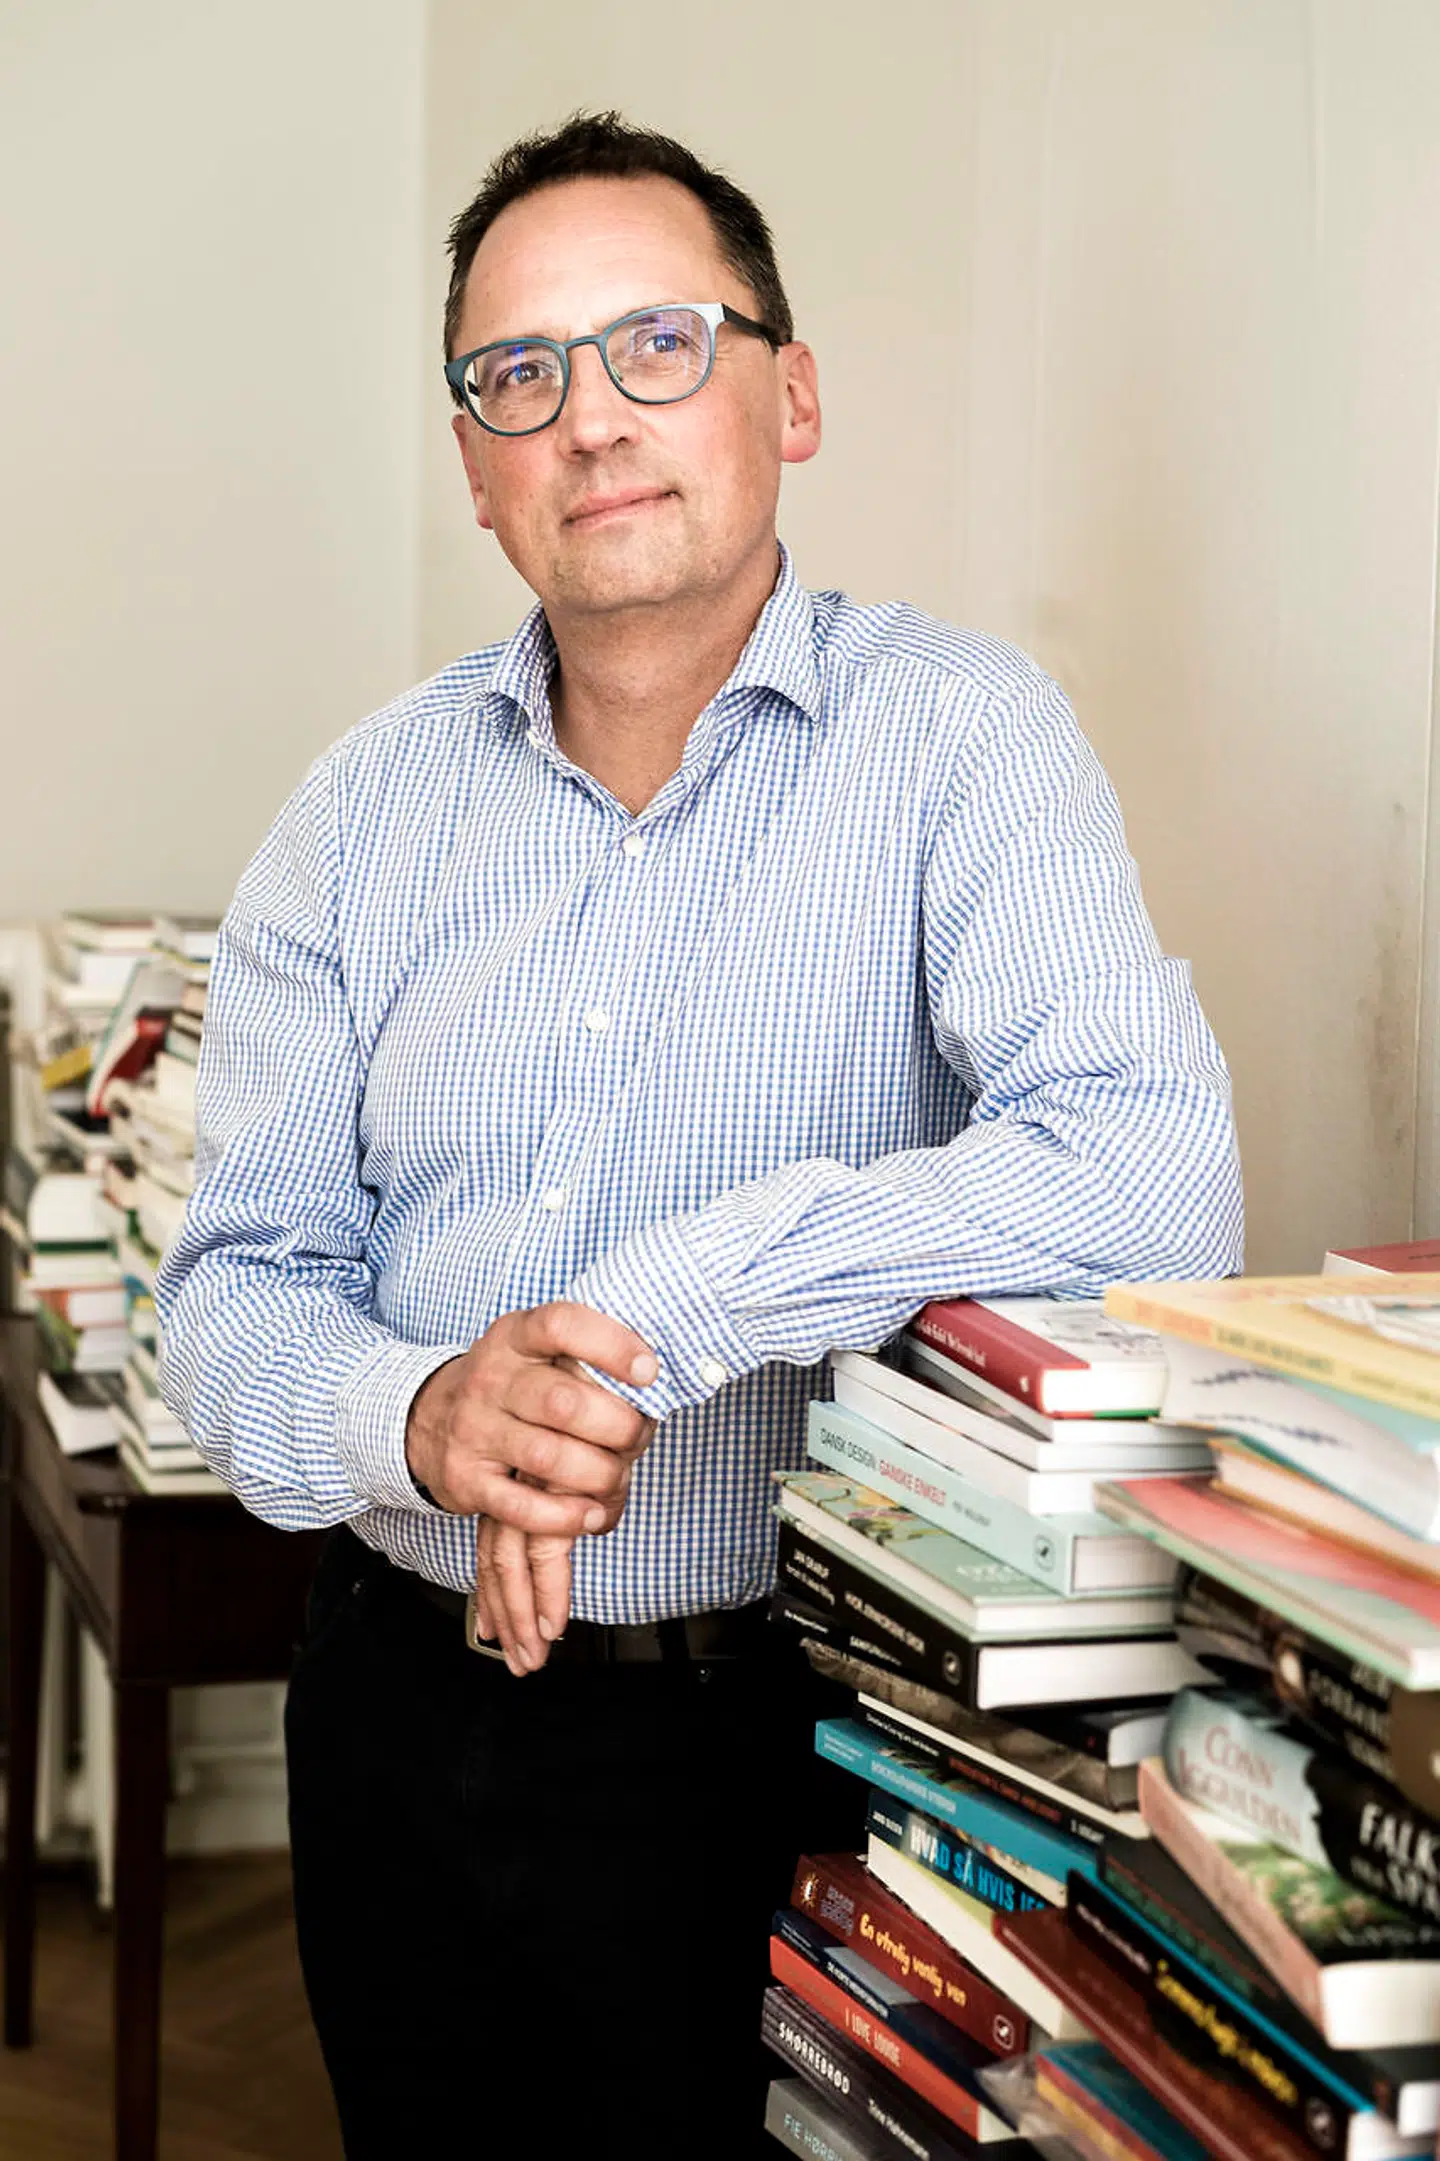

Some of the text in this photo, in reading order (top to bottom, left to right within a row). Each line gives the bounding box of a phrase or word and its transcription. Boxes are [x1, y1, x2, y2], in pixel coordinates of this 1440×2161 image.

[909, 1823, 951, 1874] HVAD
[952, 1848, 974, 1890] SÅ
[976, 1863, 1016, 1913] HVIS
[858, 1911, 876, 1941] En
[777, 2020, 851, 2095] SMØRREBRØD
[783, 2112, 802, 2140] FIE
